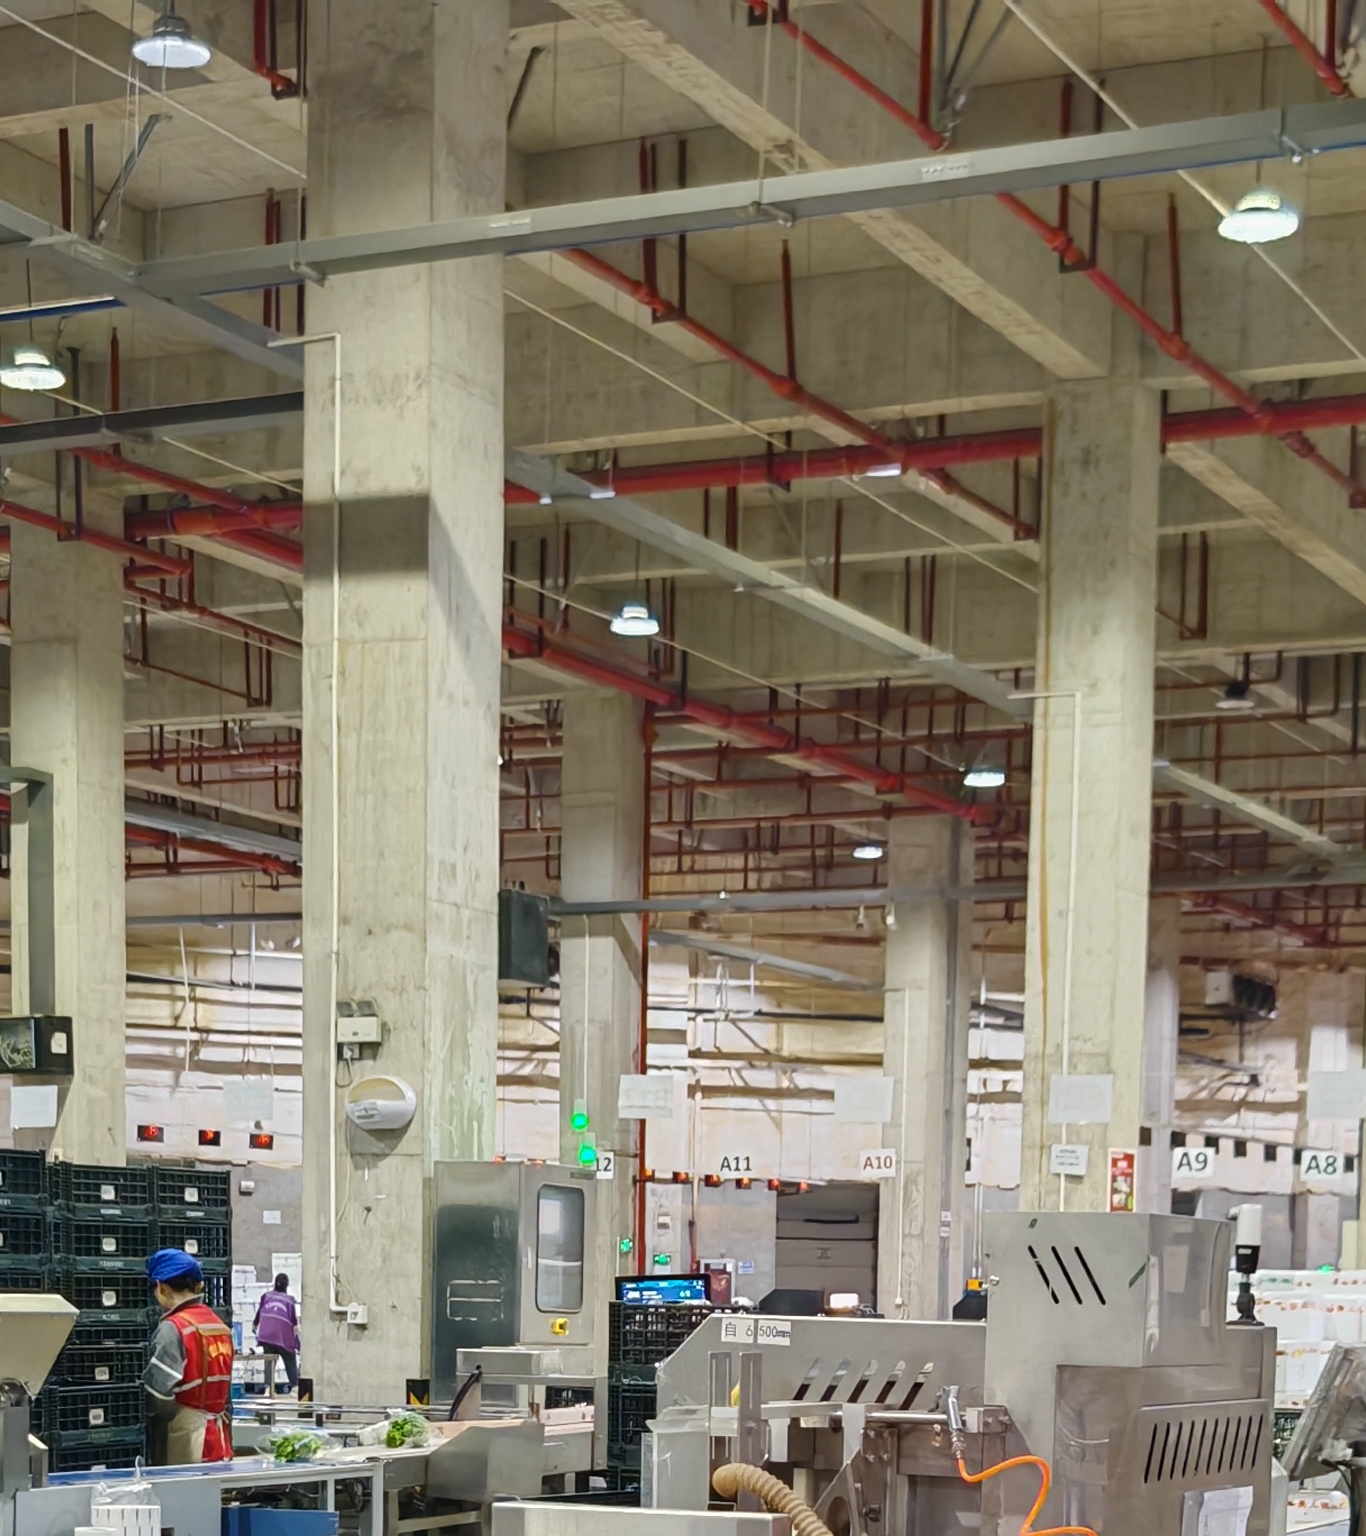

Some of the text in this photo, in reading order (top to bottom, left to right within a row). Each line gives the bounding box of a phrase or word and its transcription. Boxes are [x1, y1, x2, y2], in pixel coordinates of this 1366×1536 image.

[595, 1156, 612, 1172] 12
[720, 1155, 752, 1172] A11
[863, 1155, 893, 1170] A10
[1176, 1151, 1208, 1172] A9
[1304, 1154, 1338, 1176] A8
[745, 1324, 754, 1337] 6
